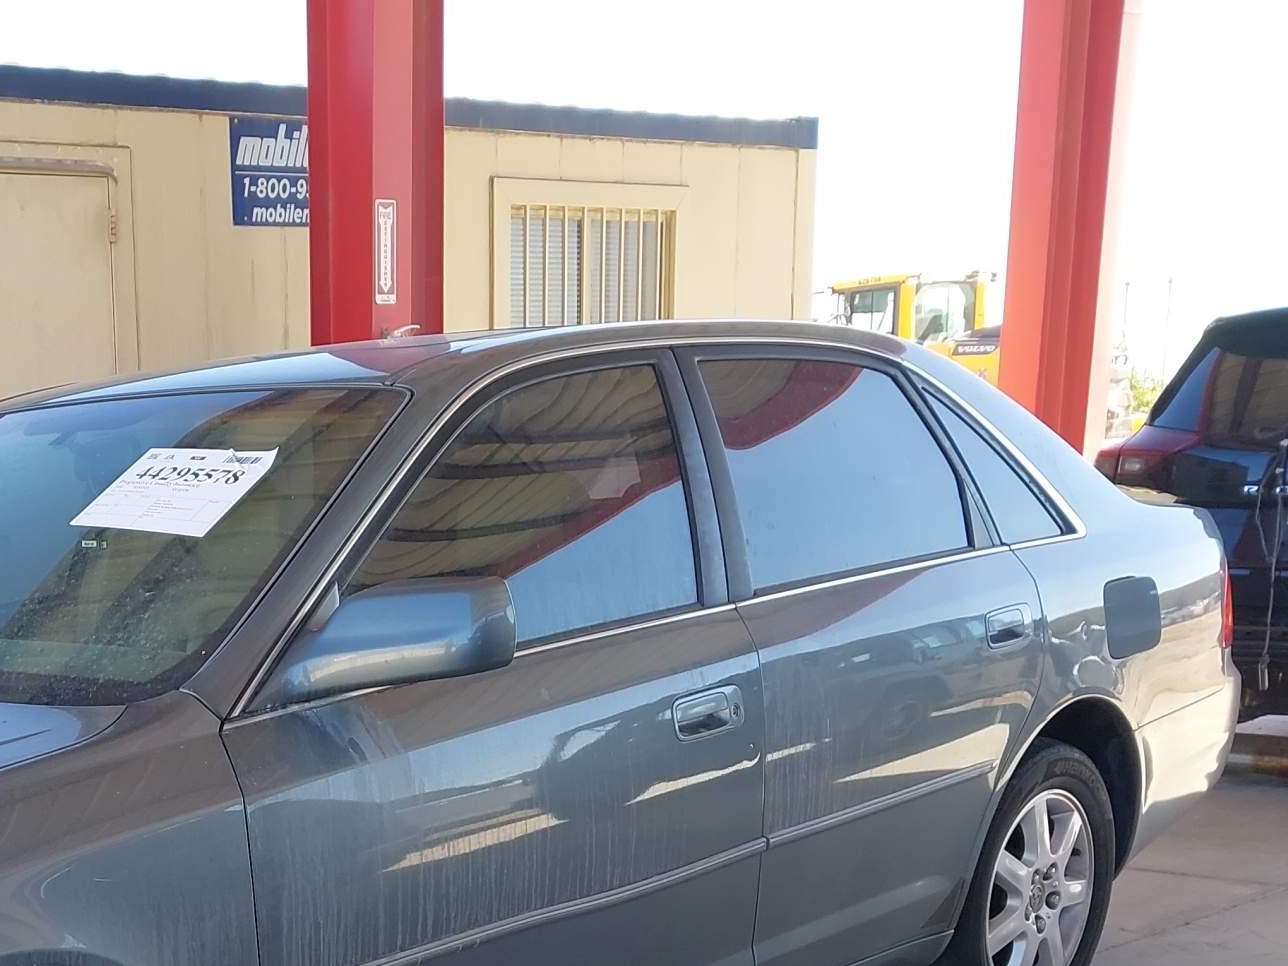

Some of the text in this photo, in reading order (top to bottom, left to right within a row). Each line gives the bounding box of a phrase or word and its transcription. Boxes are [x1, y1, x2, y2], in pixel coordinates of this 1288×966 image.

[235, 123, 309, 167] mobil
[243, 177, 309, 199] 1-800-9
[135, 465, 246, 485] 44295578
